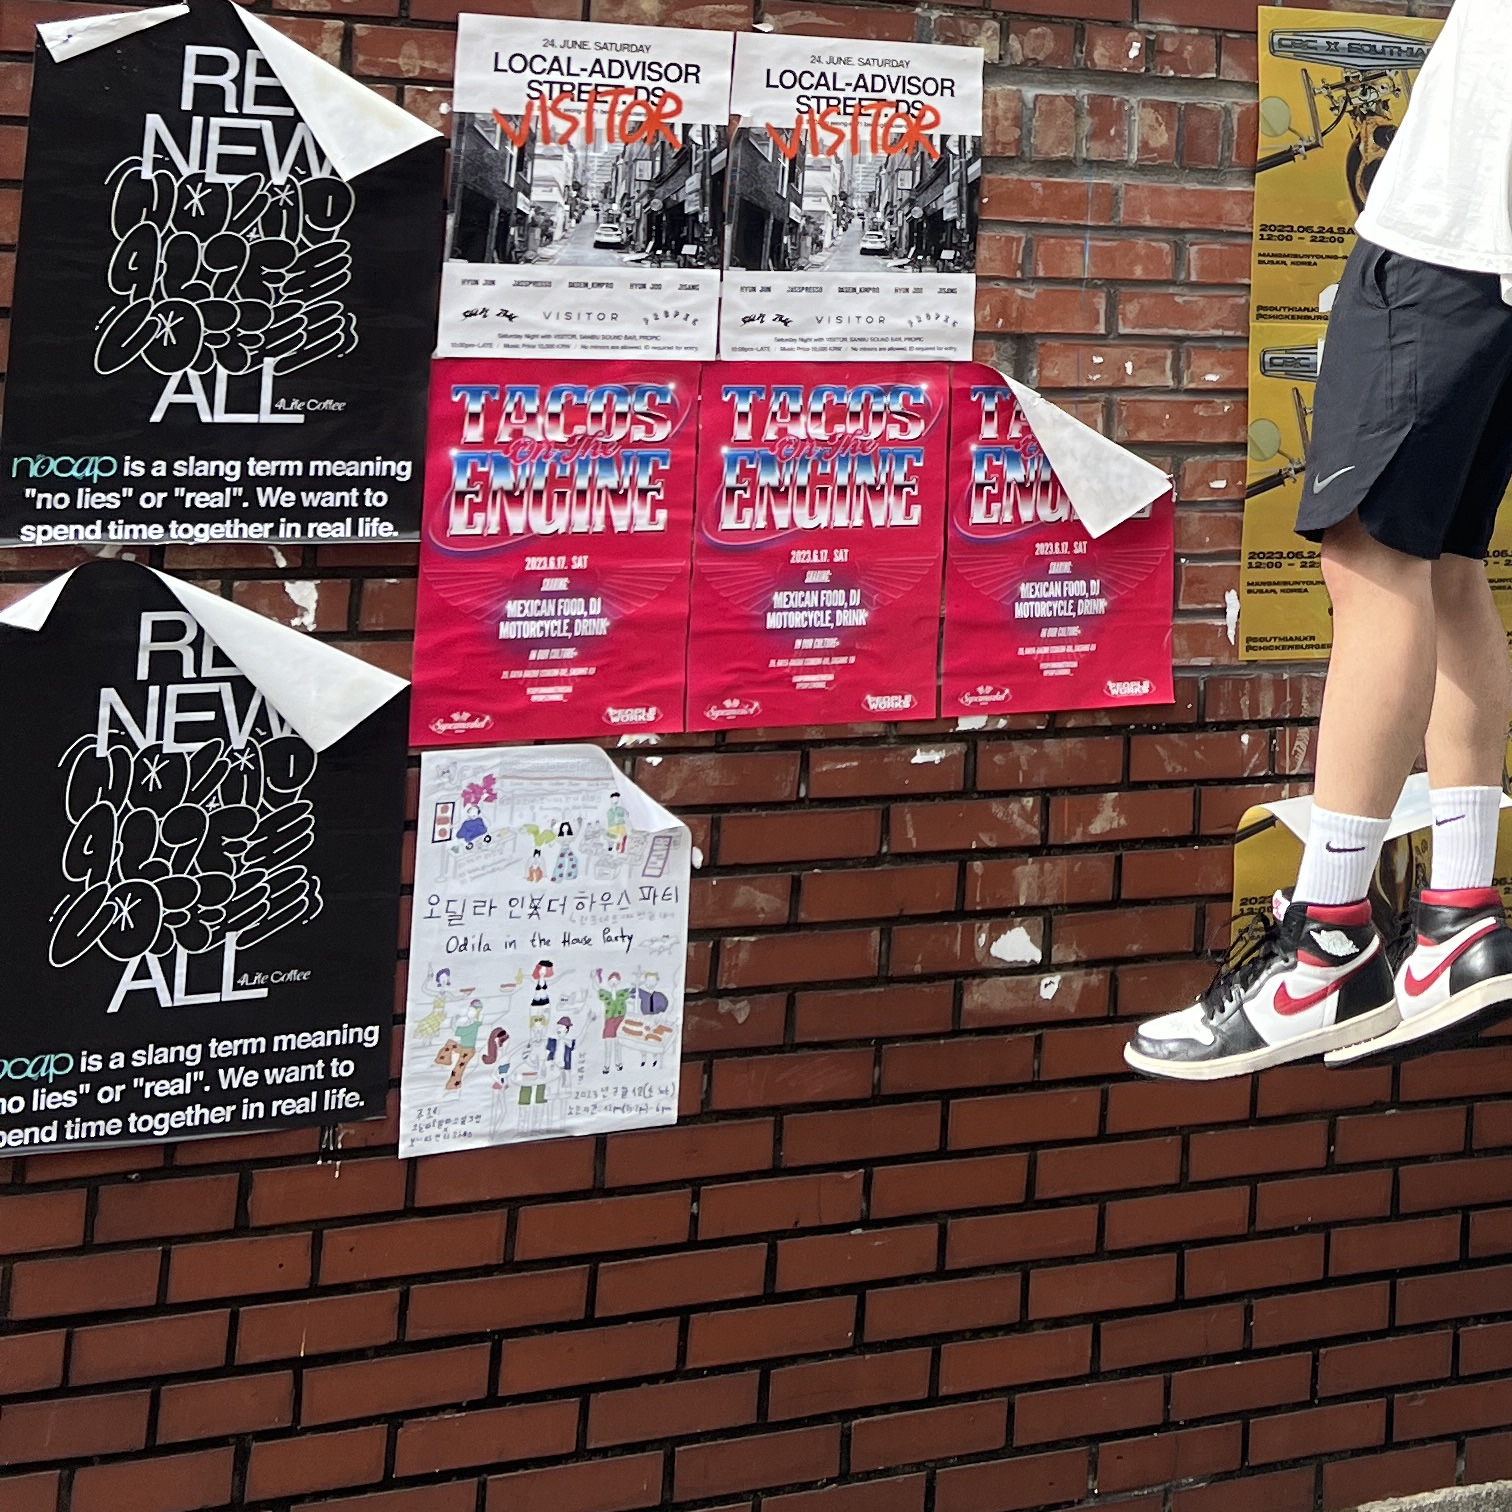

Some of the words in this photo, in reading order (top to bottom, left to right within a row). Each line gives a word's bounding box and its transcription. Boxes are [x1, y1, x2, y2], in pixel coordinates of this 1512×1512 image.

[542, 38, 558, 49] 24.
[594, 42, 651, 54] SATURDAY
[1325, 41, 1340, 52] X
[493, 52, 701, 84] LOCAL-ADVISOR
[857, 58, 911, 69] SATURDAY
[180, 45, 295, 116] RE
[765, 68, 955, 97] LOCAL-ADVISOR
[492, 88, 683, 150] VISITOR
[765, 101, 940, 160] VISITOR
[141, 114, 334, 184] NEW
[1259, 223, 1355, 235] 2023.06.24.SA
[1259, 233, 1293, 241] 12:00
[1309, 235, 1344, 243] 22:00
[543, 311, 619, 321] VISITOR
[815, 315, 886, 324] VISITOR
[150, 357, 305, 424] ALL
[306, 399, 347, 411] Coffee
[451, 384, 672, 444] TACOS
[722, 384, 926, 442] TACOS
[11, 454, 118, 484] nocap
[123, 456, 146, 477] is
[151, 460, 167, 477] a
[172, 456, 242, 482] slang
[247, 457, 303, 477] term
[309, 456, 412, 482] meaning
[25, 488, 71, 509] "no
[76, 488, 133, 509] lies"
[139, 492, 168, 509] or
[174, 488, 249, 509] "real".
[256, 487, 296, 508] We
[301, 488, 359, 508] want
[363, 488, 389, 508] to
[446, 449, 672, 537] ENGINE
[718, 447, 924, 531] ENGINE
[20, 520, 101, 545] spend
[107, 520, 164, 540] time
[168, 519, 274, 543] together
[278, 518, 301, 538] in
[307, 518, 352, 538] real
[357, 517, 399, 538] life.
[790, 550, 830, 563] 2023.6.17.
[833, 549, 848, 562] SAT
[1035, 542, 1070, 555] 2023.6.17.
[1073, 541, 1087, 554] SAT
[571, 555, 589, 569] SAT
[1247, 561, 1282, 569] 12:00
[774, 591, 819, 608] MEXICAN
[820, 590, 848, 608] FOOD,
[849, 589, 860, 606] DJ
[1020, 582, 1062, 599] MEXICAN
[1063, 581, 1089, 597] FOOD,
[1090, 580, 1100, 595] DJ
[507, 599, 556, 618] MEXICAN
[557, 598, 587, 617] FOOD,
[590, 597, 601, 615] DJ
[1014, 601, 1077, 618] MOTORCYCLE,
[1077, 599, 1106, 615] DRINK
[499, 619, 572, 639] MOTORCYCLE,
[574, 618, 608, 637] DRINK
[766, 611, 834, 629] MOTORCYCLE,
[835, 610, 867, 626] DRINK
[423, 894, 498, 927] 오딜라
[573, 890, 632, 914] 하우스
[638, 886, 679, 904] 파티
[446, 933, 492, 953] Odila
[504, 937, 517, 950] in
[530, 932, 551, 949] the
[603, 928, 634, 954] Party
[107, 931, 268, 1014] ALL
[270, 969, 311, 983] Coffee
[80, 1050, 103, 1073] is
[109, 1051, 125, 1070] a
[131, 1043, 202, 1067] slang
[208, 1038, 266, 1059] term
[273, 1023, 380, 1048] meaning
[32, 1083, 90, 1111] lies"
[97, 1084, 126, 1104] or
[133, 1071, 210, 1099] "real".
[218, 1066, 259, 1089] We
[264, 1059, 325, 1085] want
[330, 1058, 355, 1078] to
[64, 1117, 123, 1140] time
[128, 1103, 236, 1136] together
[241, 1098, 265, 1120] in
[271, 1091, 317, 1117] real
[323, 1088, 365, 1111] life.
